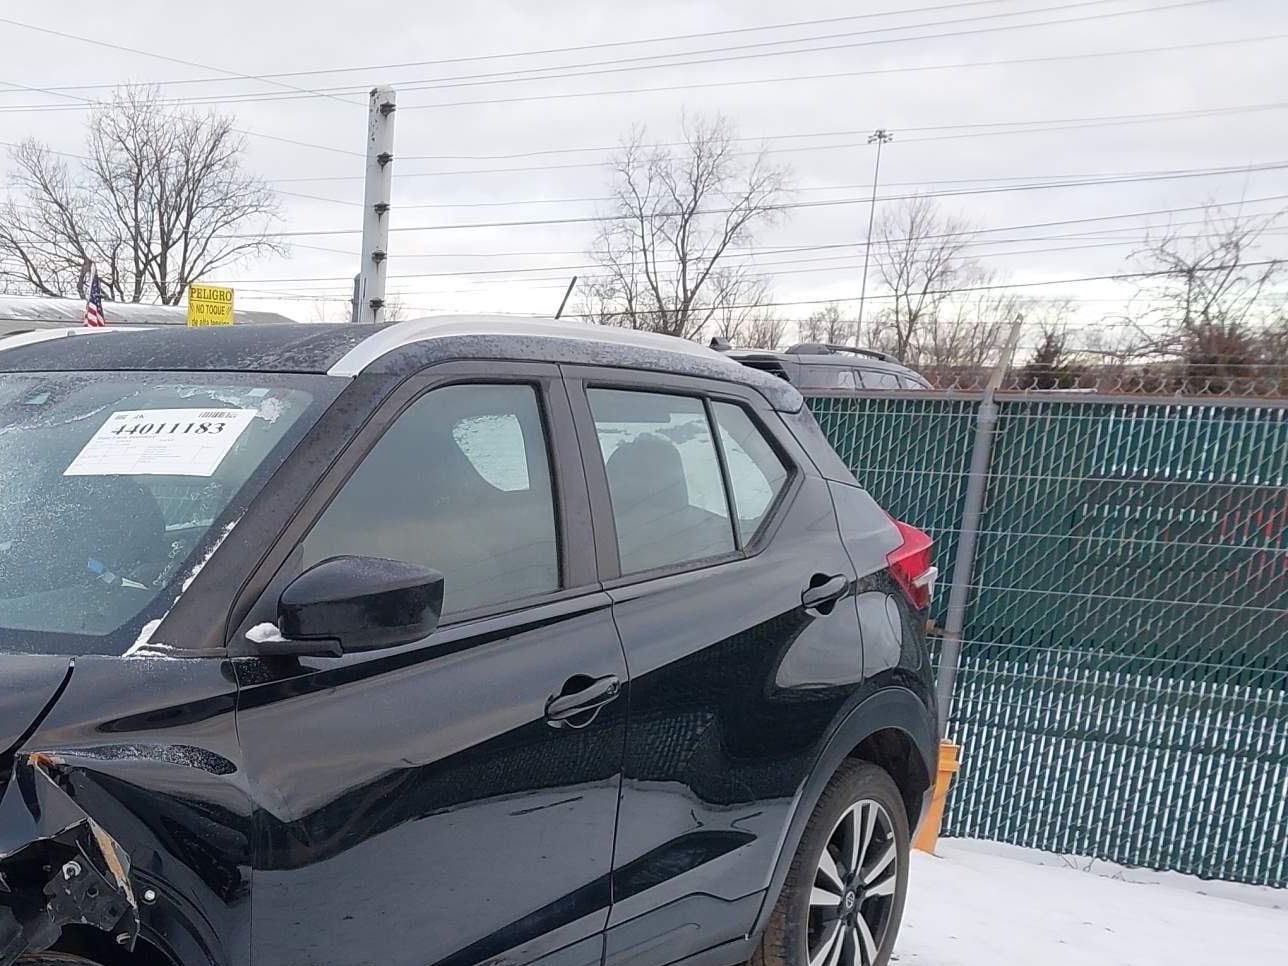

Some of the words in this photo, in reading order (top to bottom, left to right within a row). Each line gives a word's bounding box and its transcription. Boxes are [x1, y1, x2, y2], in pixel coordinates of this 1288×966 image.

[191, 287, 232, 301] PELIGRO
[196, 304, 205, 314] NO
[206, 304, 225, 315] TOQUE
[112, 421, 226, 435] 44011183
